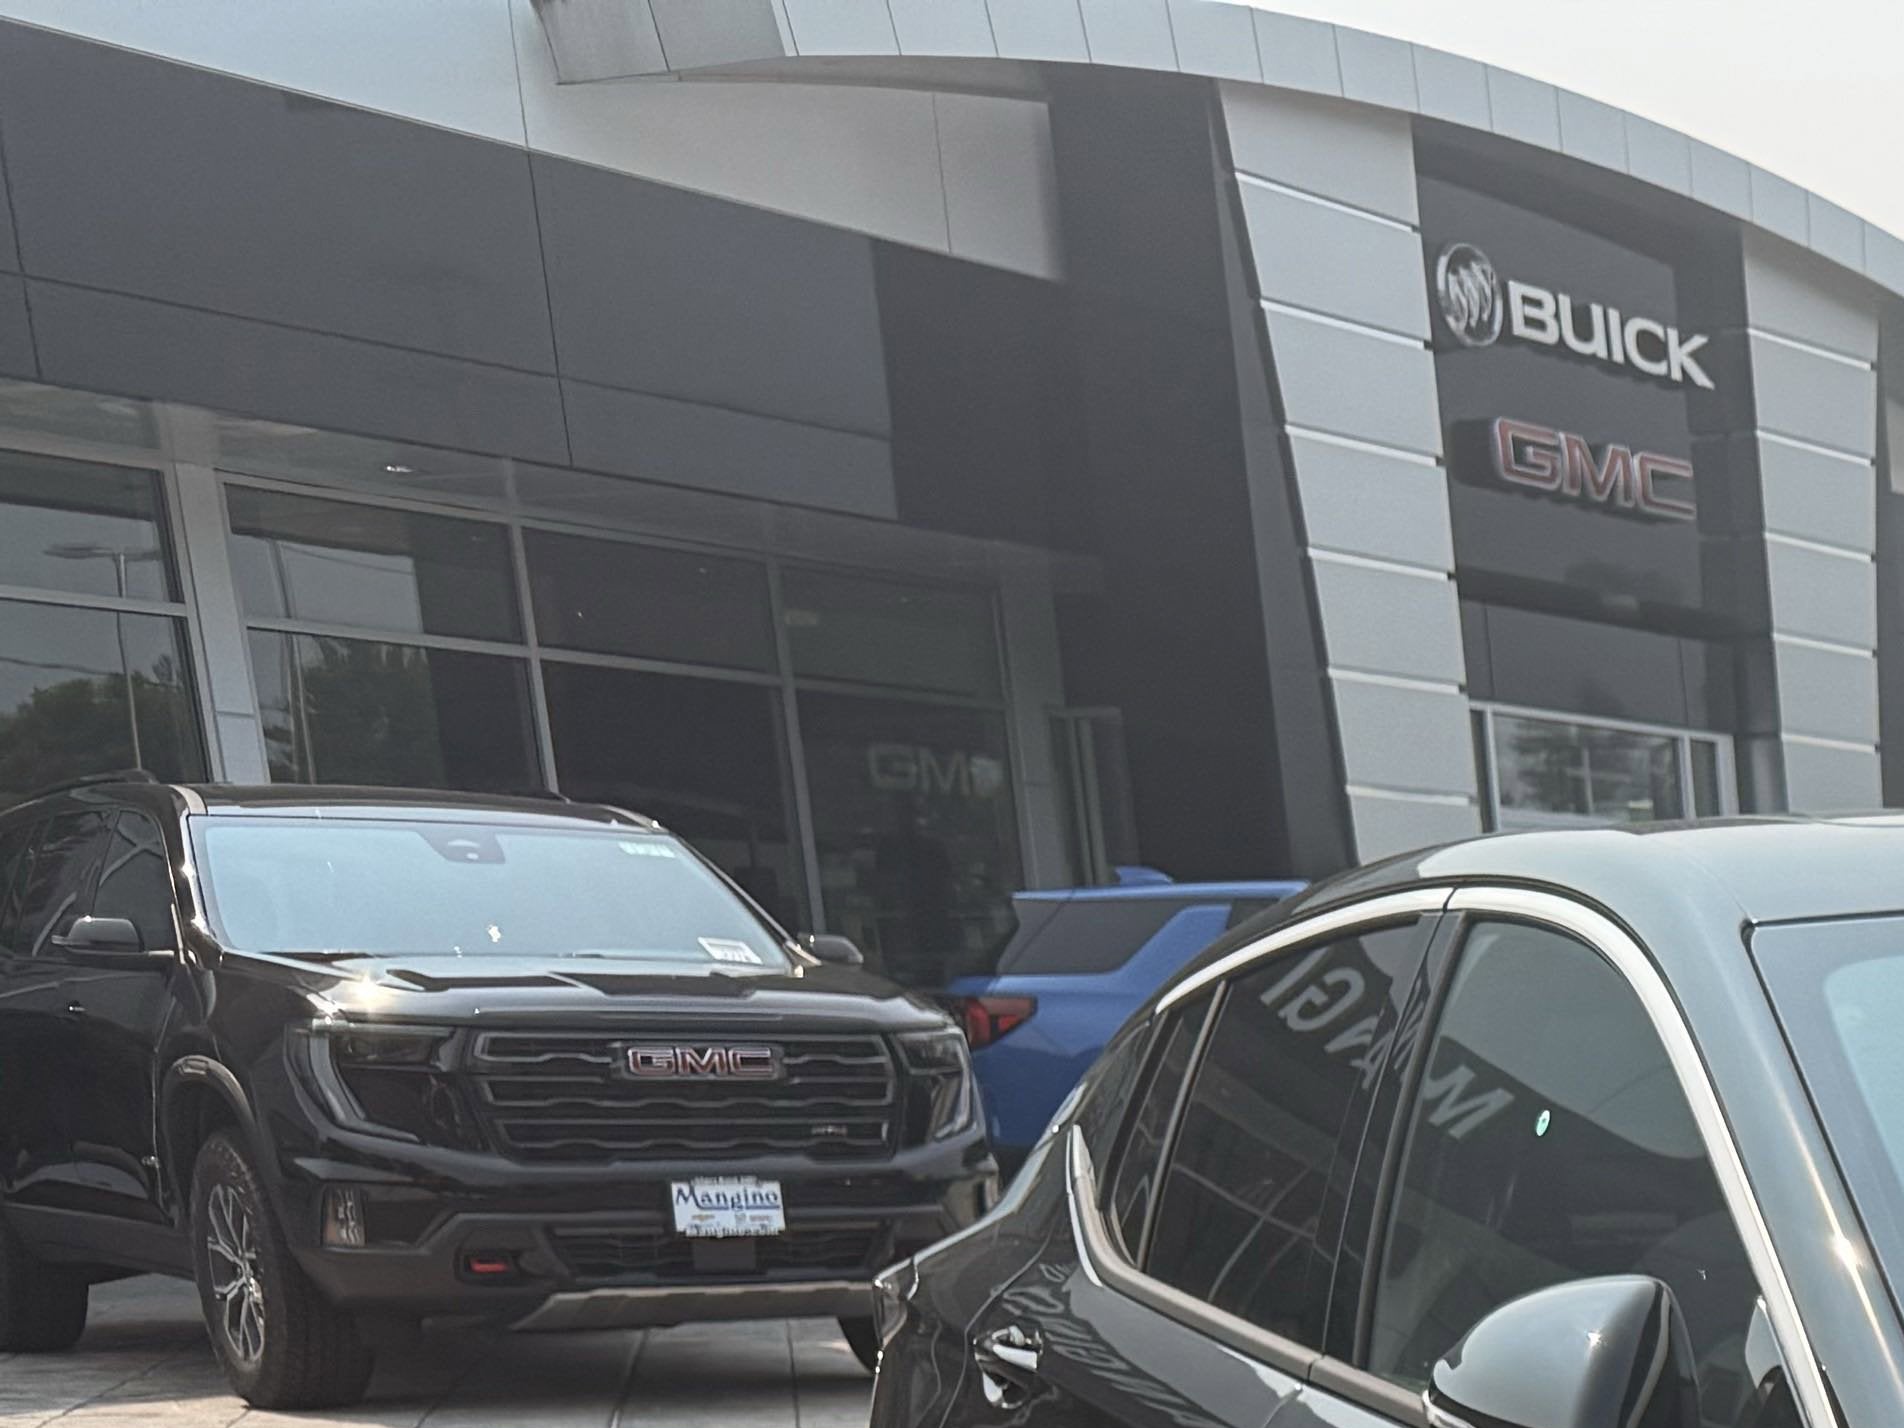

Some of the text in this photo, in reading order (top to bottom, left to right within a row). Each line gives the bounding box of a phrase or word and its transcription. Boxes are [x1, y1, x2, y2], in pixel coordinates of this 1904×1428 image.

[1508, 280, 1715, 389] BUICK
[1494, 417, 1697, 520] GMC
[627, 1045, 775, 1077] GMC
[675, 1181, 780, 1211] Mangino
